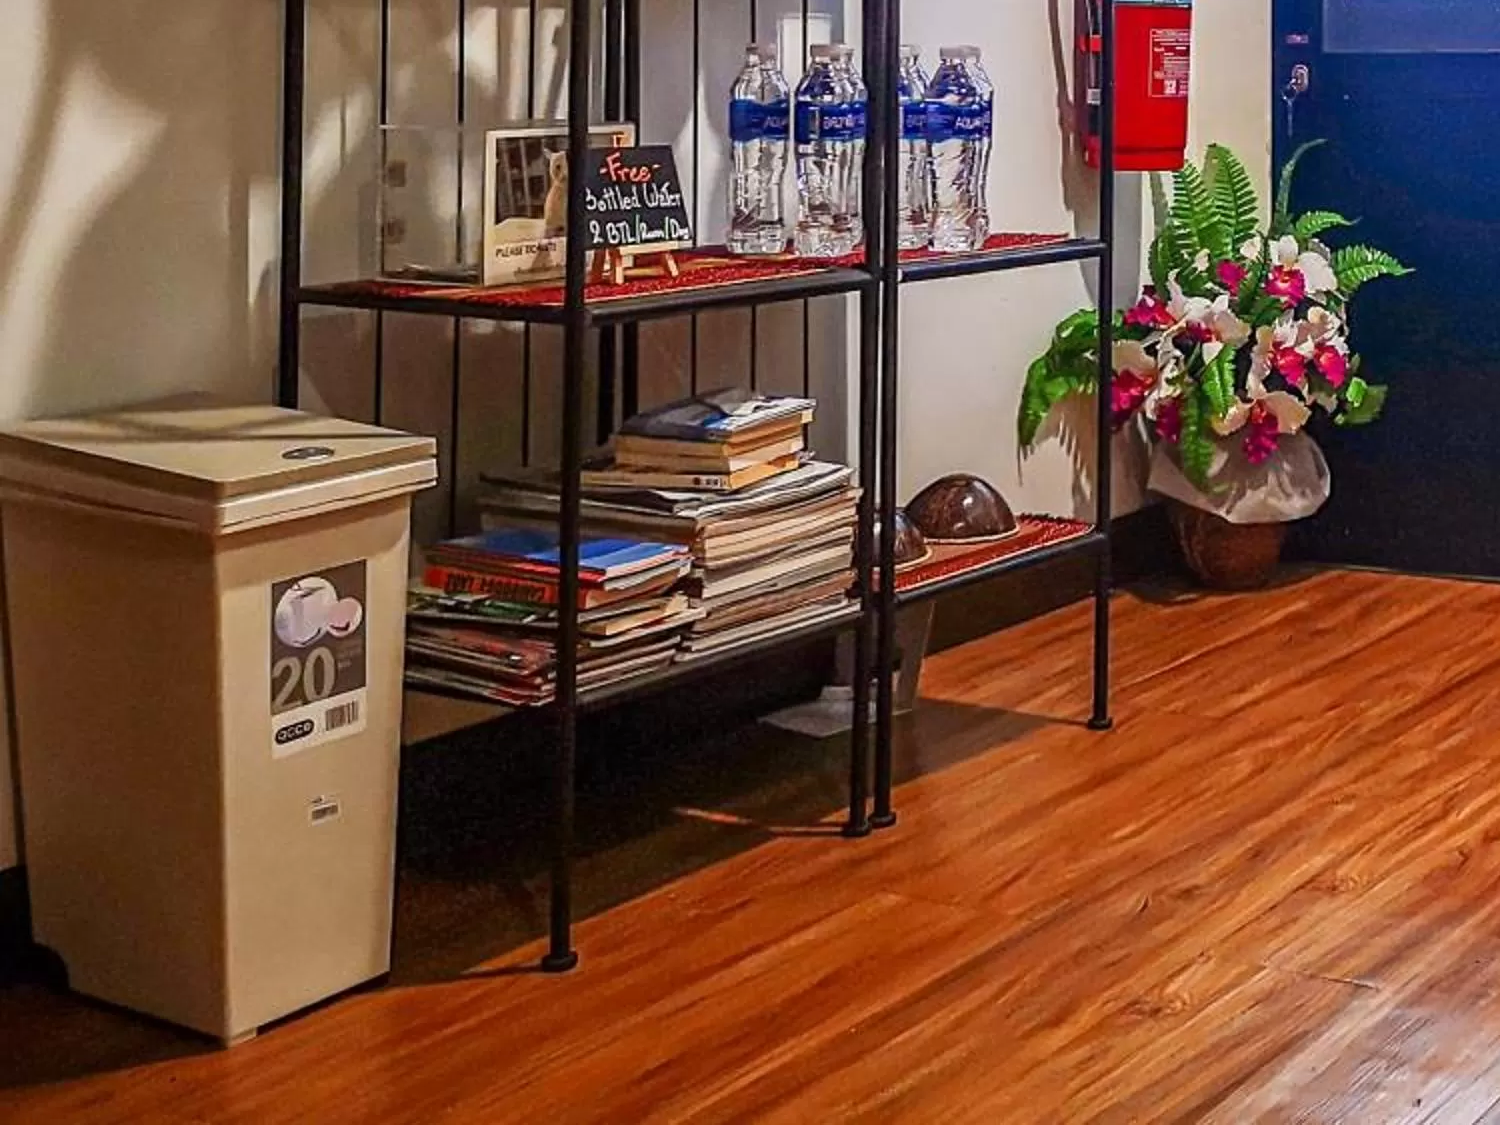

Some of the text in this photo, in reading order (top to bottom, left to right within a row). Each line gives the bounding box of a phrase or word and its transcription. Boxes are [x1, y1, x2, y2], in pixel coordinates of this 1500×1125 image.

[643, 180, 683, 210] Water
[589, 219, 604, 244] 2
[273, 645, 336, 709] 20
